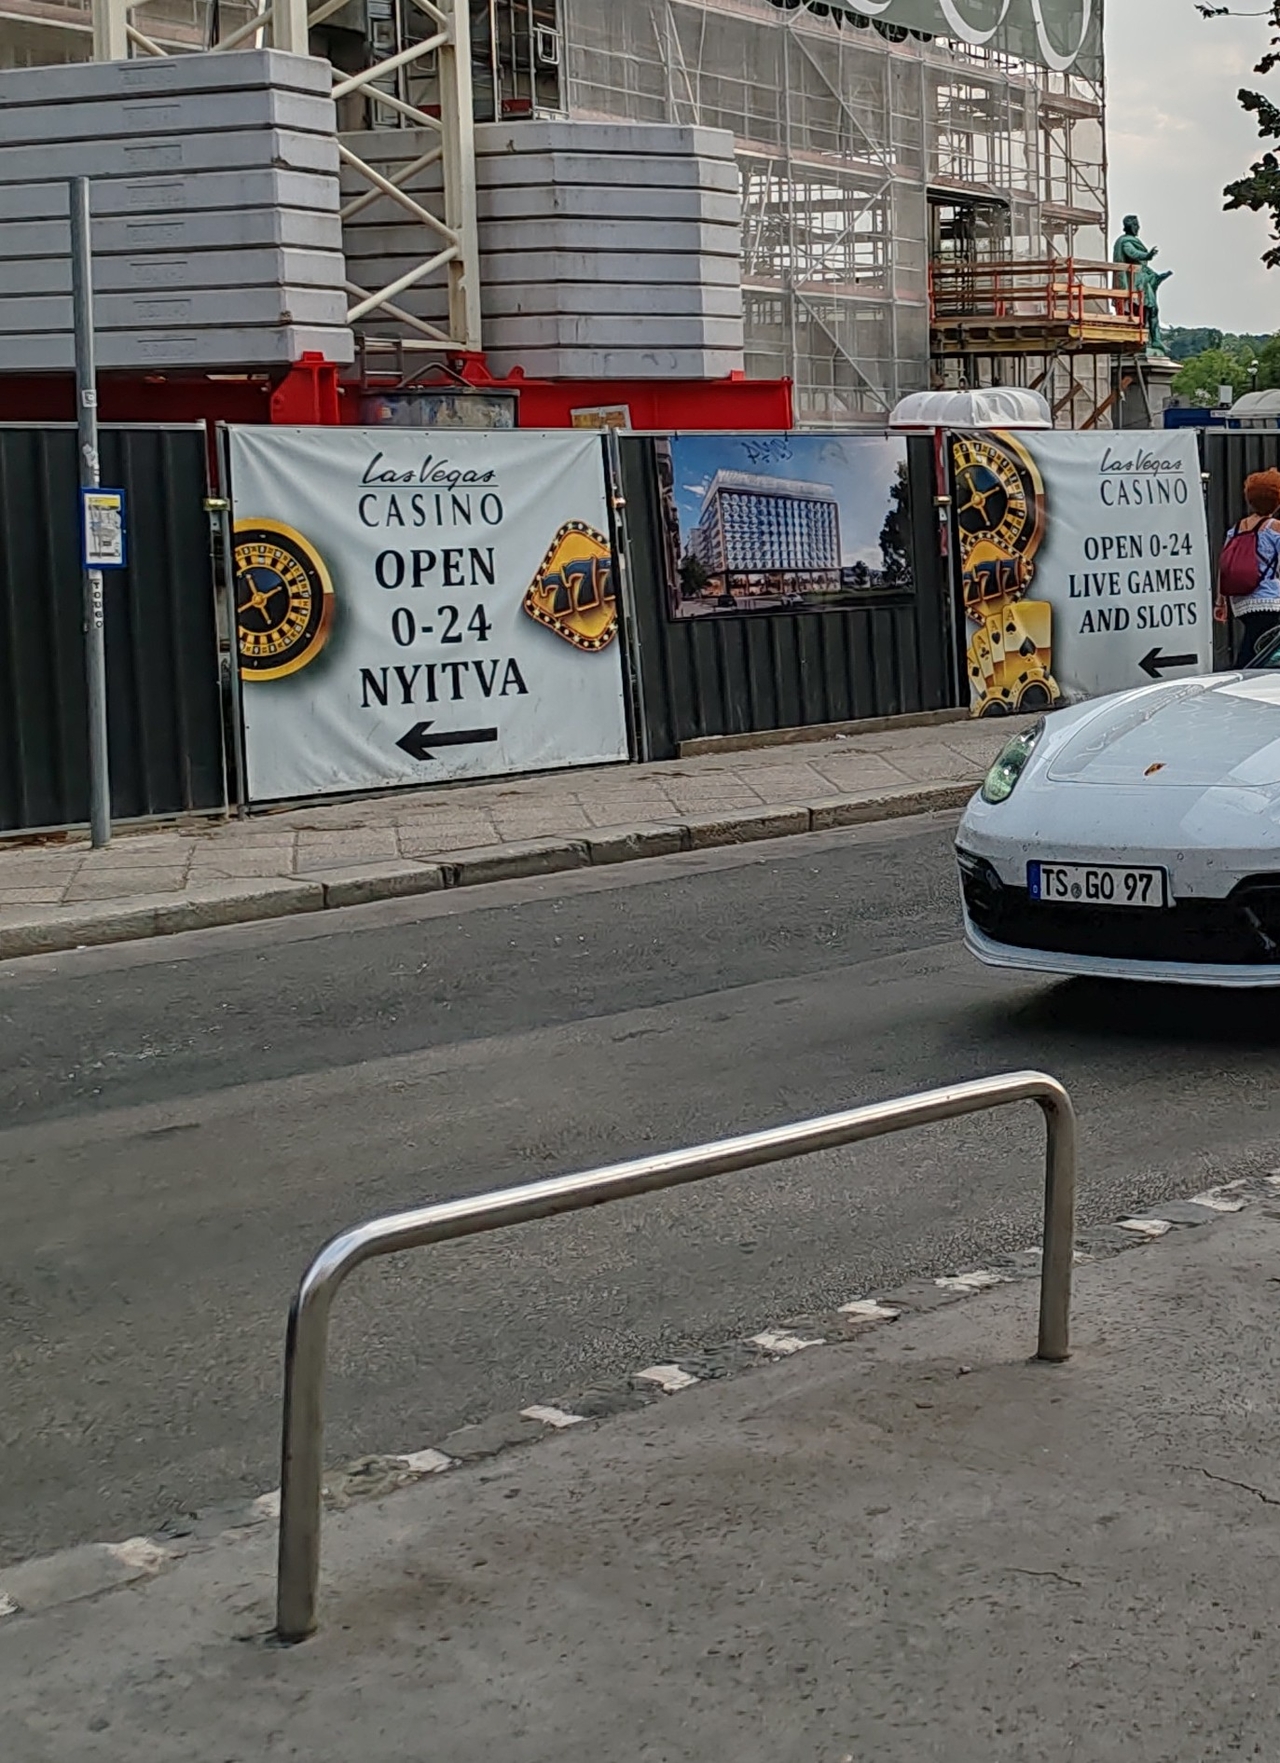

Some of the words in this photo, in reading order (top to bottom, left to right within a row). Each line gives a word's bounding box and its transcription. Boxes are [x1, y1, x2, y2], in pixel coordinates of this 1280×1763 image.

[361, 451, 416, 485] Las
[418, 454, 497, 491] Vegas
[1100, 447, 1134, 473] Las
[1135, 448, 1183, 477] Vegas
[1100, 478, 1188, 506] CASINO
[358, 493, 504, 527] CASINO
[1084, 534, 1143, 561] OPEN
[1149, 532, 1193, 557] 0-24
[374, 546, 497, 590] OPEN
[1068, 571, 1121, 598] LIVE
[1127, 567, 1195, 594] GAMES
[391, 603, 493, 647] 0-24
[1078, 607, 1130, 634] AND
[1136, 602, 1197, 630] SLOTS
[358, 657, 530, 708] NYITVA
[1042, 868, 1068, 897] TS
[1085, 871, 1114, 900] GO
[1124, 872, 1153, 902] 97
